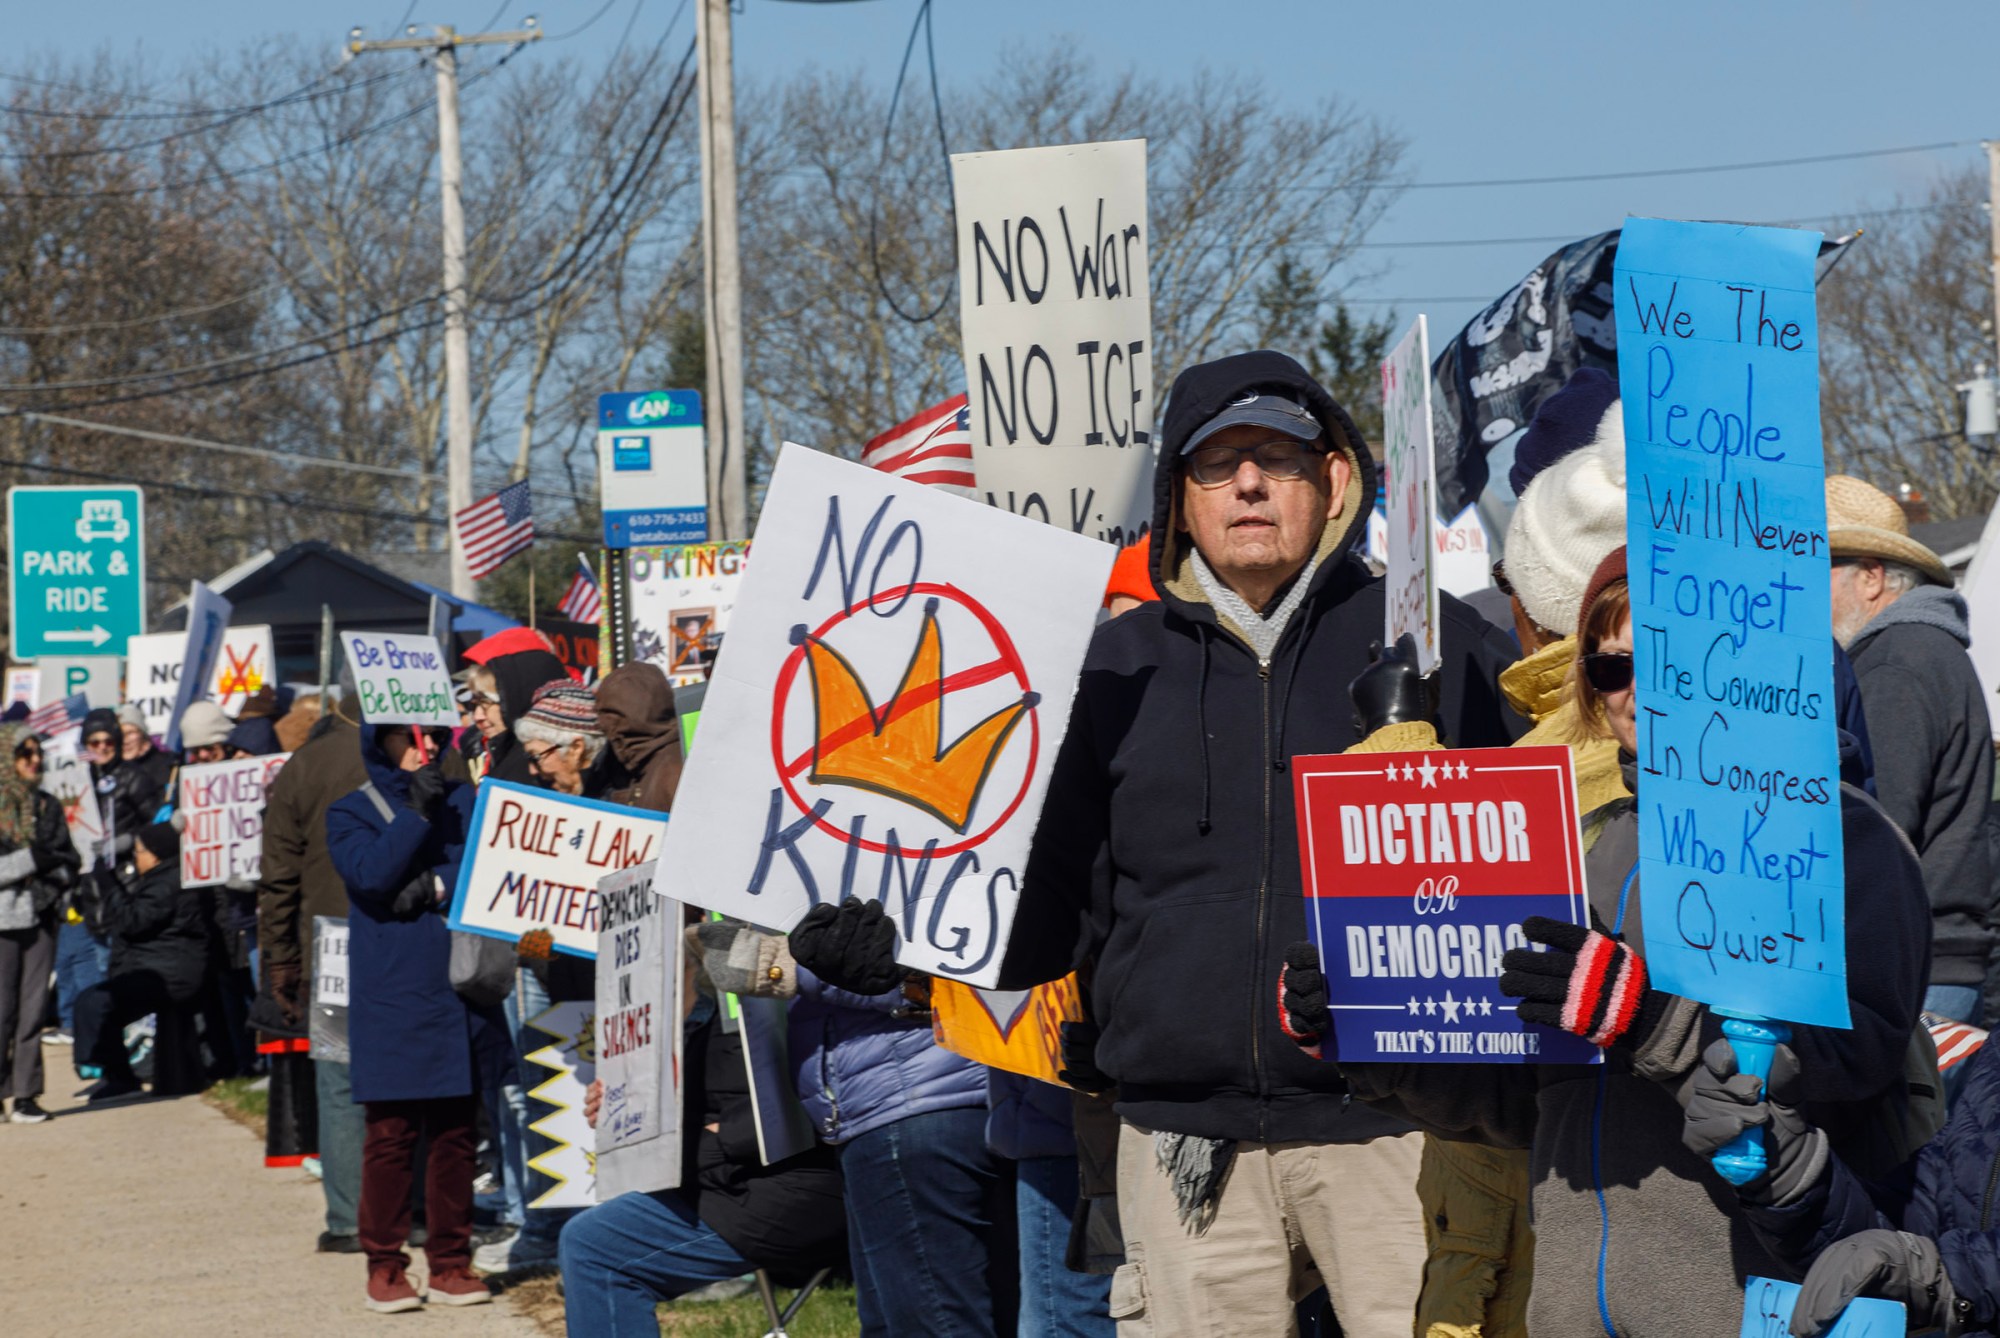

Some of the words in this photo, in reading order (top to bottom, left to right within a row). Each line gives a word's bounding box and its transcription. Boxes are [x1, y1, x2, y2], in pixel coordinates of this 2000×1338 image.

[972, 215, 1049, 306] NO
[1058, 197, 1140, 300] War
[1630, 276, 1694, 338] We
[1725, 284, 1803, 351] The
[978, 344, 1059, 447] NO
[1648, 344, 1786, 482] People
[628, 512, 706, 527] 610-776-7433
[629, 530, 706, 543] lantabus.com
[1643, 473, 1722, 539] Will
[1734, 477, 1825, 558] Never
[24, 551, 94, 576] PARK
[108, 551, 129, 575] &
[803, 494, 922, 617] NO
[46, 587, 109, 613] RIDE
[1649, 543, 1804, 648] Forget
[66, 666, 90, 696] P
[352, 638, 383, 668] Be
[384, 640, 439, 670] Brave
[1642, 623, 1693, 700] The
[1704, 632, 1822, 719] Cowards
[360, 679, 389, 715] Be
[387, 677, 453, 721] Peaceful
[1644, 706, 1683, 780] In
[1699, 711, 1830, 816] Congress
[183, 809, 222, 844] NOT
[488, 800, 567, 857] RULE
[586, 820, 653, 869] LAW
[1340, 801, 1531, 864] DICTATOR
[184, 844, 223, 880] NOT
[747, 787, 1018, 976] KINGS
[1657, 803, 1725, 874] Who
[1740, 808, 1829, 910] Kept
[487, 870, 598, 932] MATTER
[1414, 875, 1459, 915] OR
[615, 926, 640, 970] DIES
[1346, 924, 1547, 978] DEMOCRA
[1677, 881, 1824, 976] Quiet!
[619, 973, 632, 1008] IN
[602, 1003, 651, 1059] SILENCE
[1374, 1029, 1435, 1054] THAT'S
[1437, 1031, 1474, 1054] THE
[1476, 1031, 1540, 1055] CHOICE
